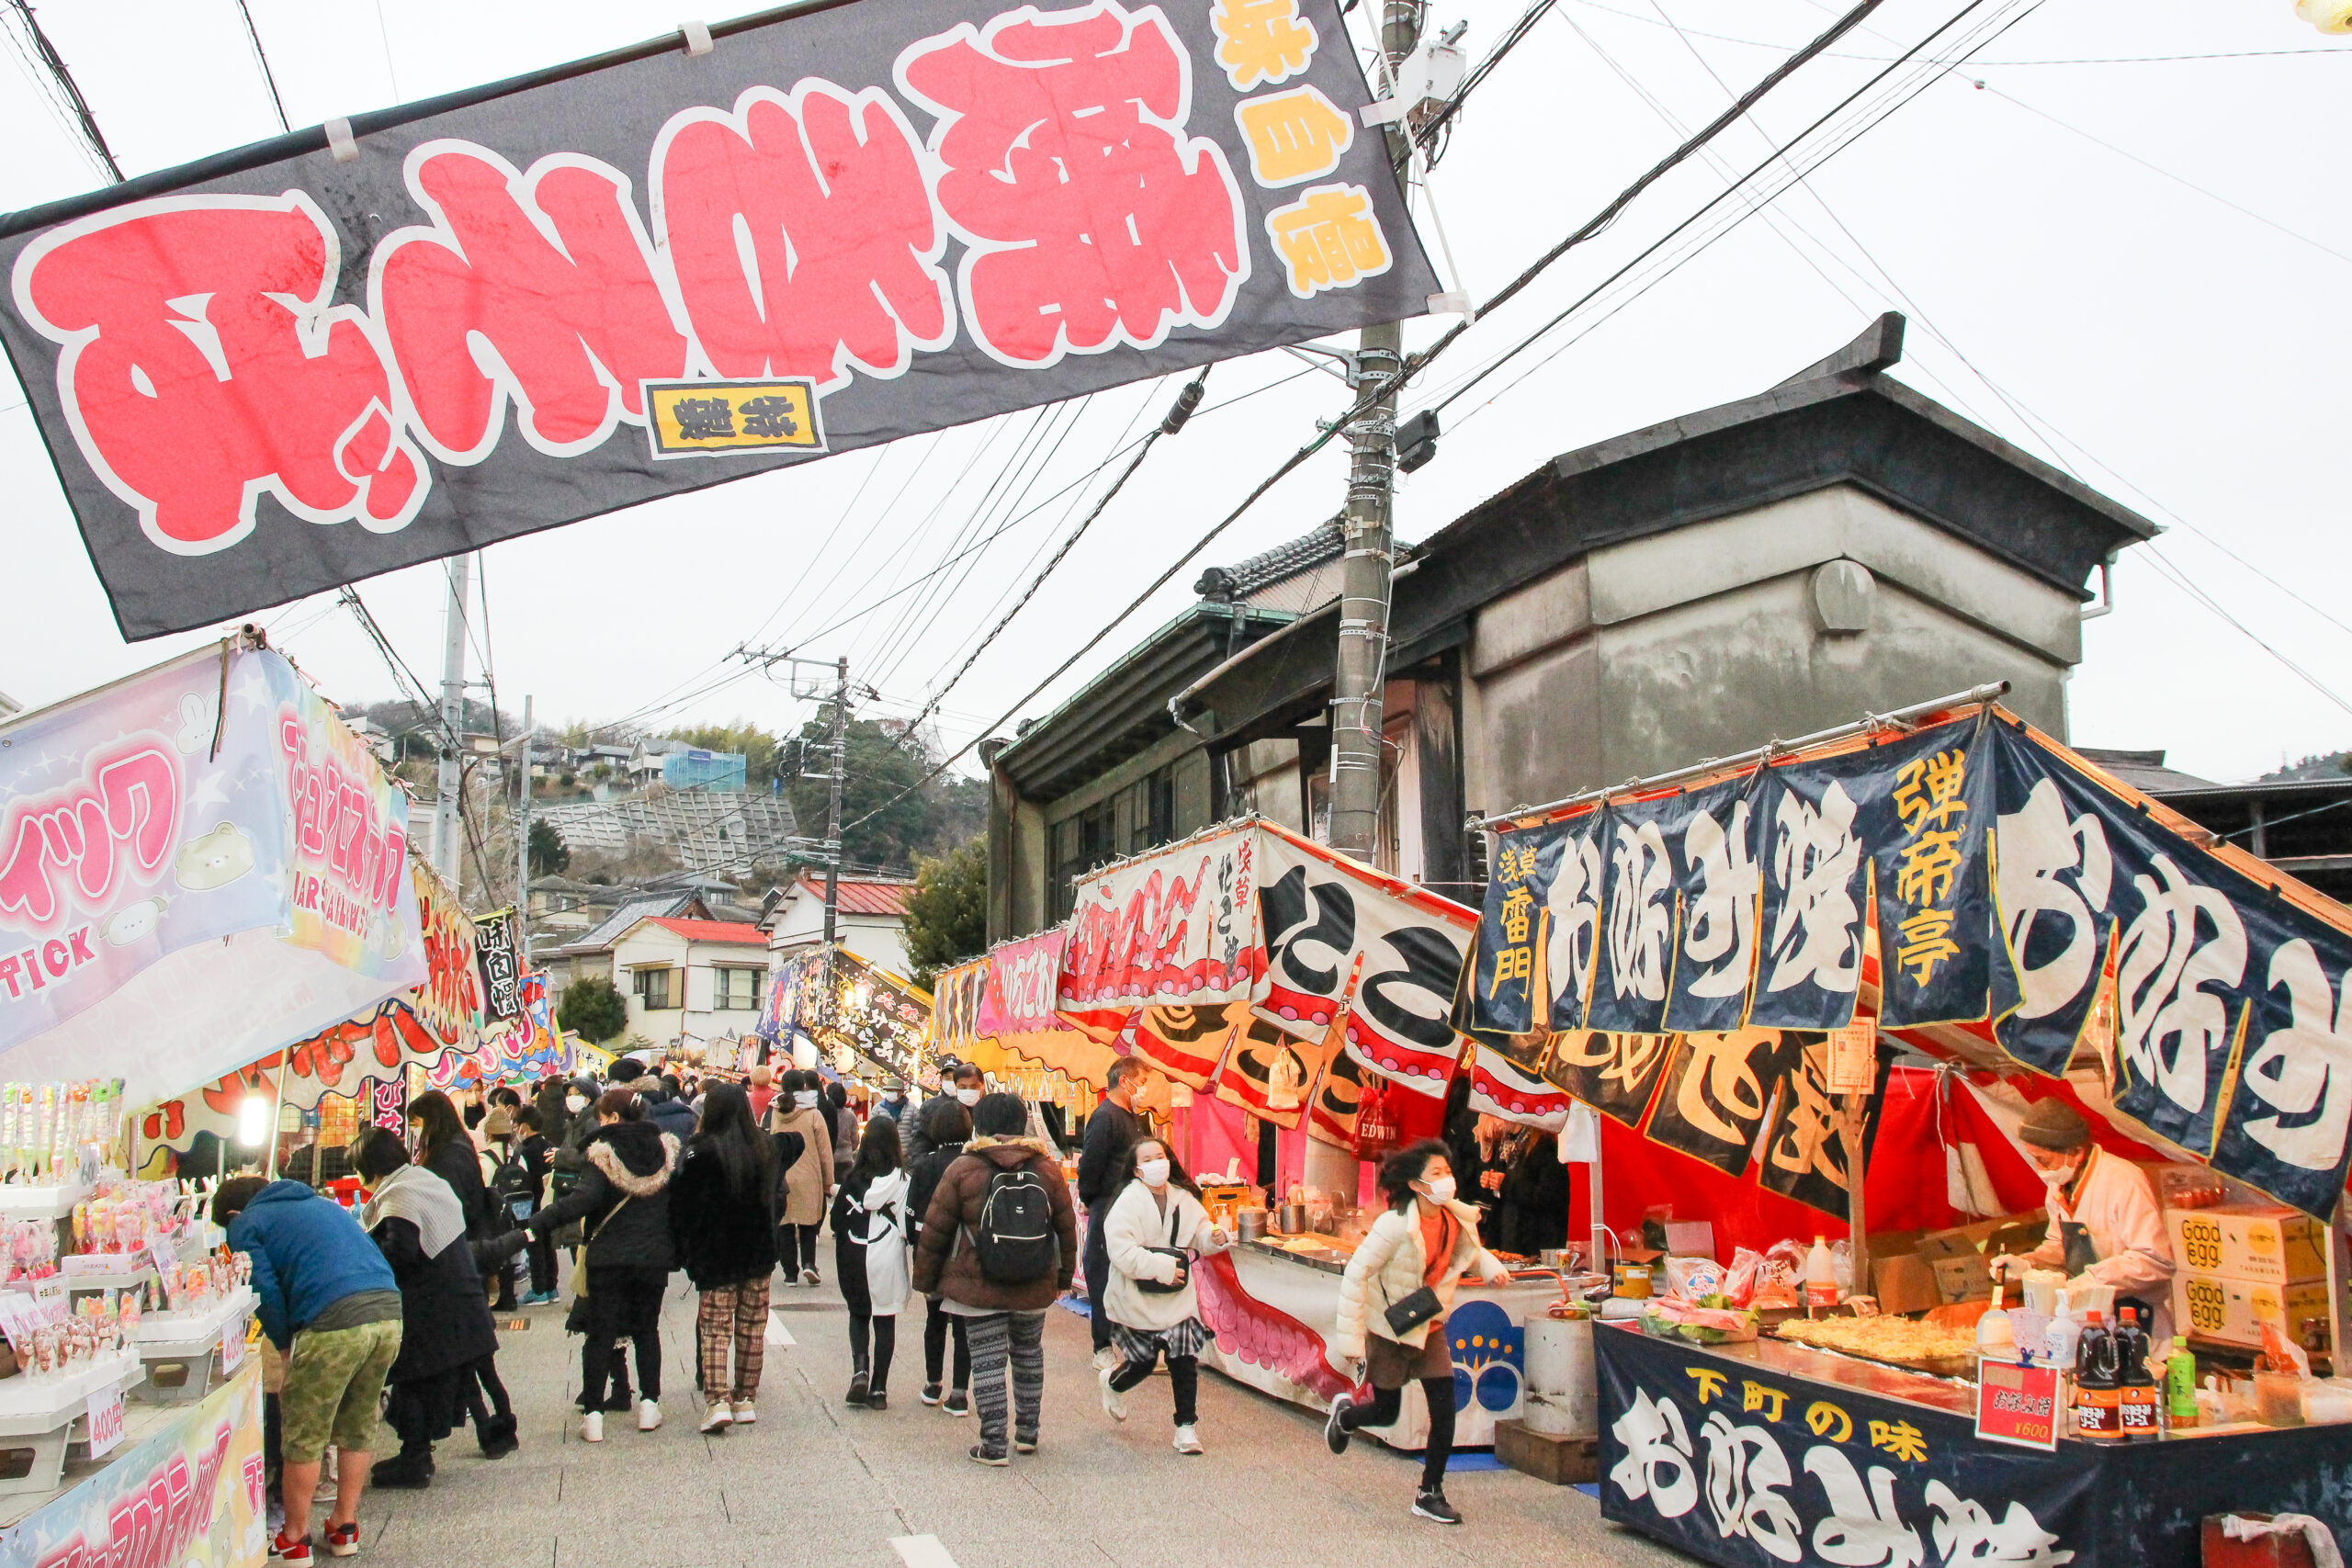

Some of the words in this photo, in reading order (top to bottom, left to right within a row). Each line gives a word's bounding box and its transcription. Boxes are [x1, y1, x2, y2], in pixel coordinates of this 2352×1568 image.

[11, 0, 1252, 556] 焼きそば
[672, 394, 798, 444] 特製
[1547, 779, 1862, 1001] お好み焼
[478, 919, 516, 1017] 味自慢
[2182, 1219, 2222, 1243] Good
[2186, 1280, 2225, 1305] Good
[93, 1402, 123, 1444] 400円
[1685, 1366, 1928, 1462] 下町の味
[1994, 1390, 2052, 1417] お好み焼
[2015, 1422, 2049, 1438] ¥600
